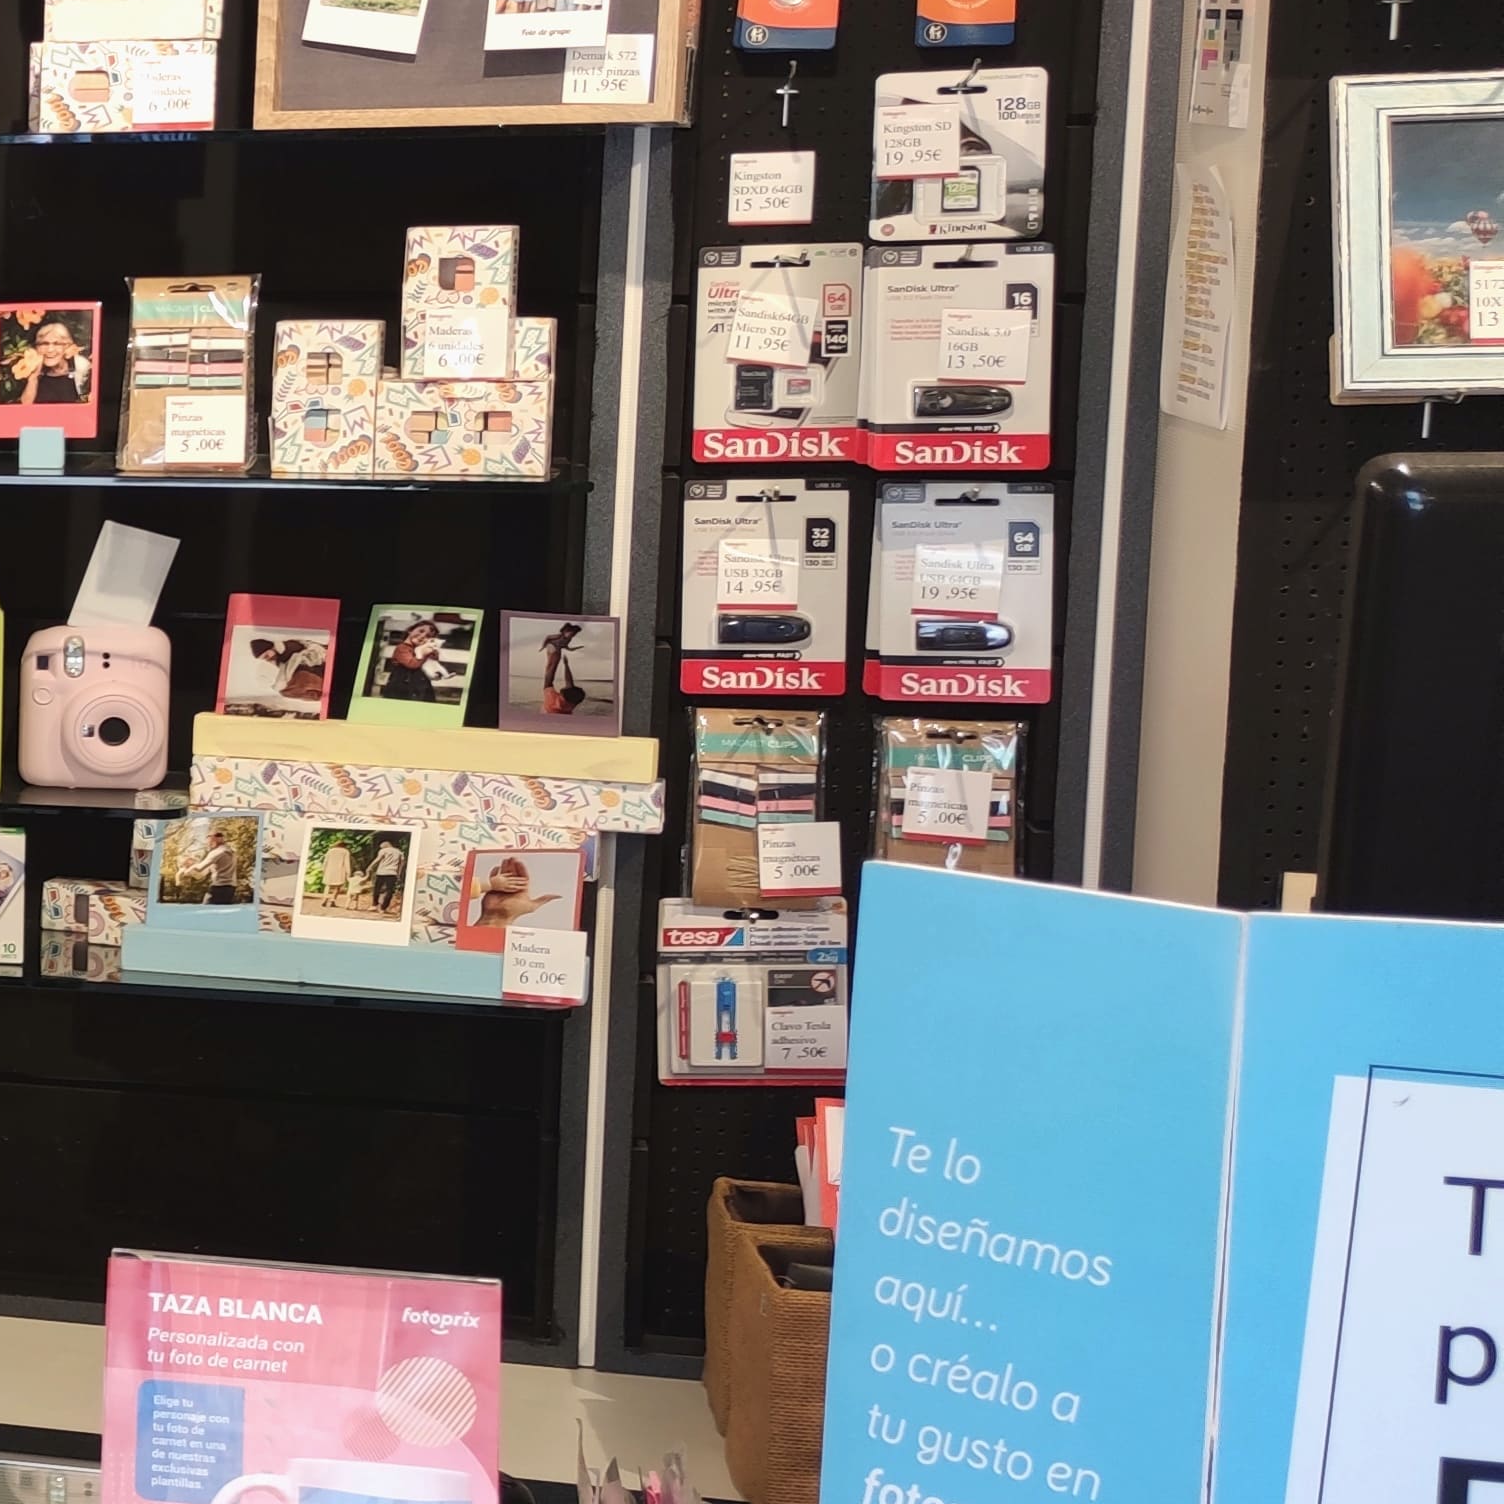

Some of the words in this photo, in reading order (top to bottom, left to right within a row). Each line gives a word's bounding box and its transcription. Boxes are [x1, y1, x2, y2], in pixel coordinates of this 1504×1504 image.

[883, 121, 932, 135] Kingston
[935, 121, 952, 132] SD
[734, 169, 781, 184] Kingston
[733, 183, 769, 196] SDXD
[772, 183, 802, 195] 64GB
[704, 431, 846, 458] SanDisk
[896, 440, 1023, 464] SanDisk
[702, 667, 822, 689] SanDisk
[901, 673, 1026, 696] SanDisk
[667, 929, 721, 945] tesa
[771, 1021, 801, 1032] Clavo
[804, 1021, 830, 1032] Tesla
[889, 1127, 930, 1174] Te
[943, 1137, 981, 1184] lo
[879, 1201, 1111, 1287] diseñamos
[148, 1292, 212, 1316] TAZA
[218, 1300, 323, 1325] BLANCA
[874, 1273, 997, 1334] aquí...
[401, 1307, 480, 1329] fotoprix
[148, 1328, 268, 1352] Personalizada
[273, 1340, 304, 1353] con
[148, 1348, 165, 1364] tu
[169, 1351, 204, 1367] foto
[208, 1354, 229, 1368] de
[233, 1356, 288, 1373] carnet
[871, 1343, 894, 1373] o
[908, 1348, 1039, 1412] créalo
[1050, 1391, 1079, 1423] a
[868, 1405, 906, 1443] tu
[918, 1419, 1033, 1480] gusto
[1046, 1454, 1100, 1501] en
